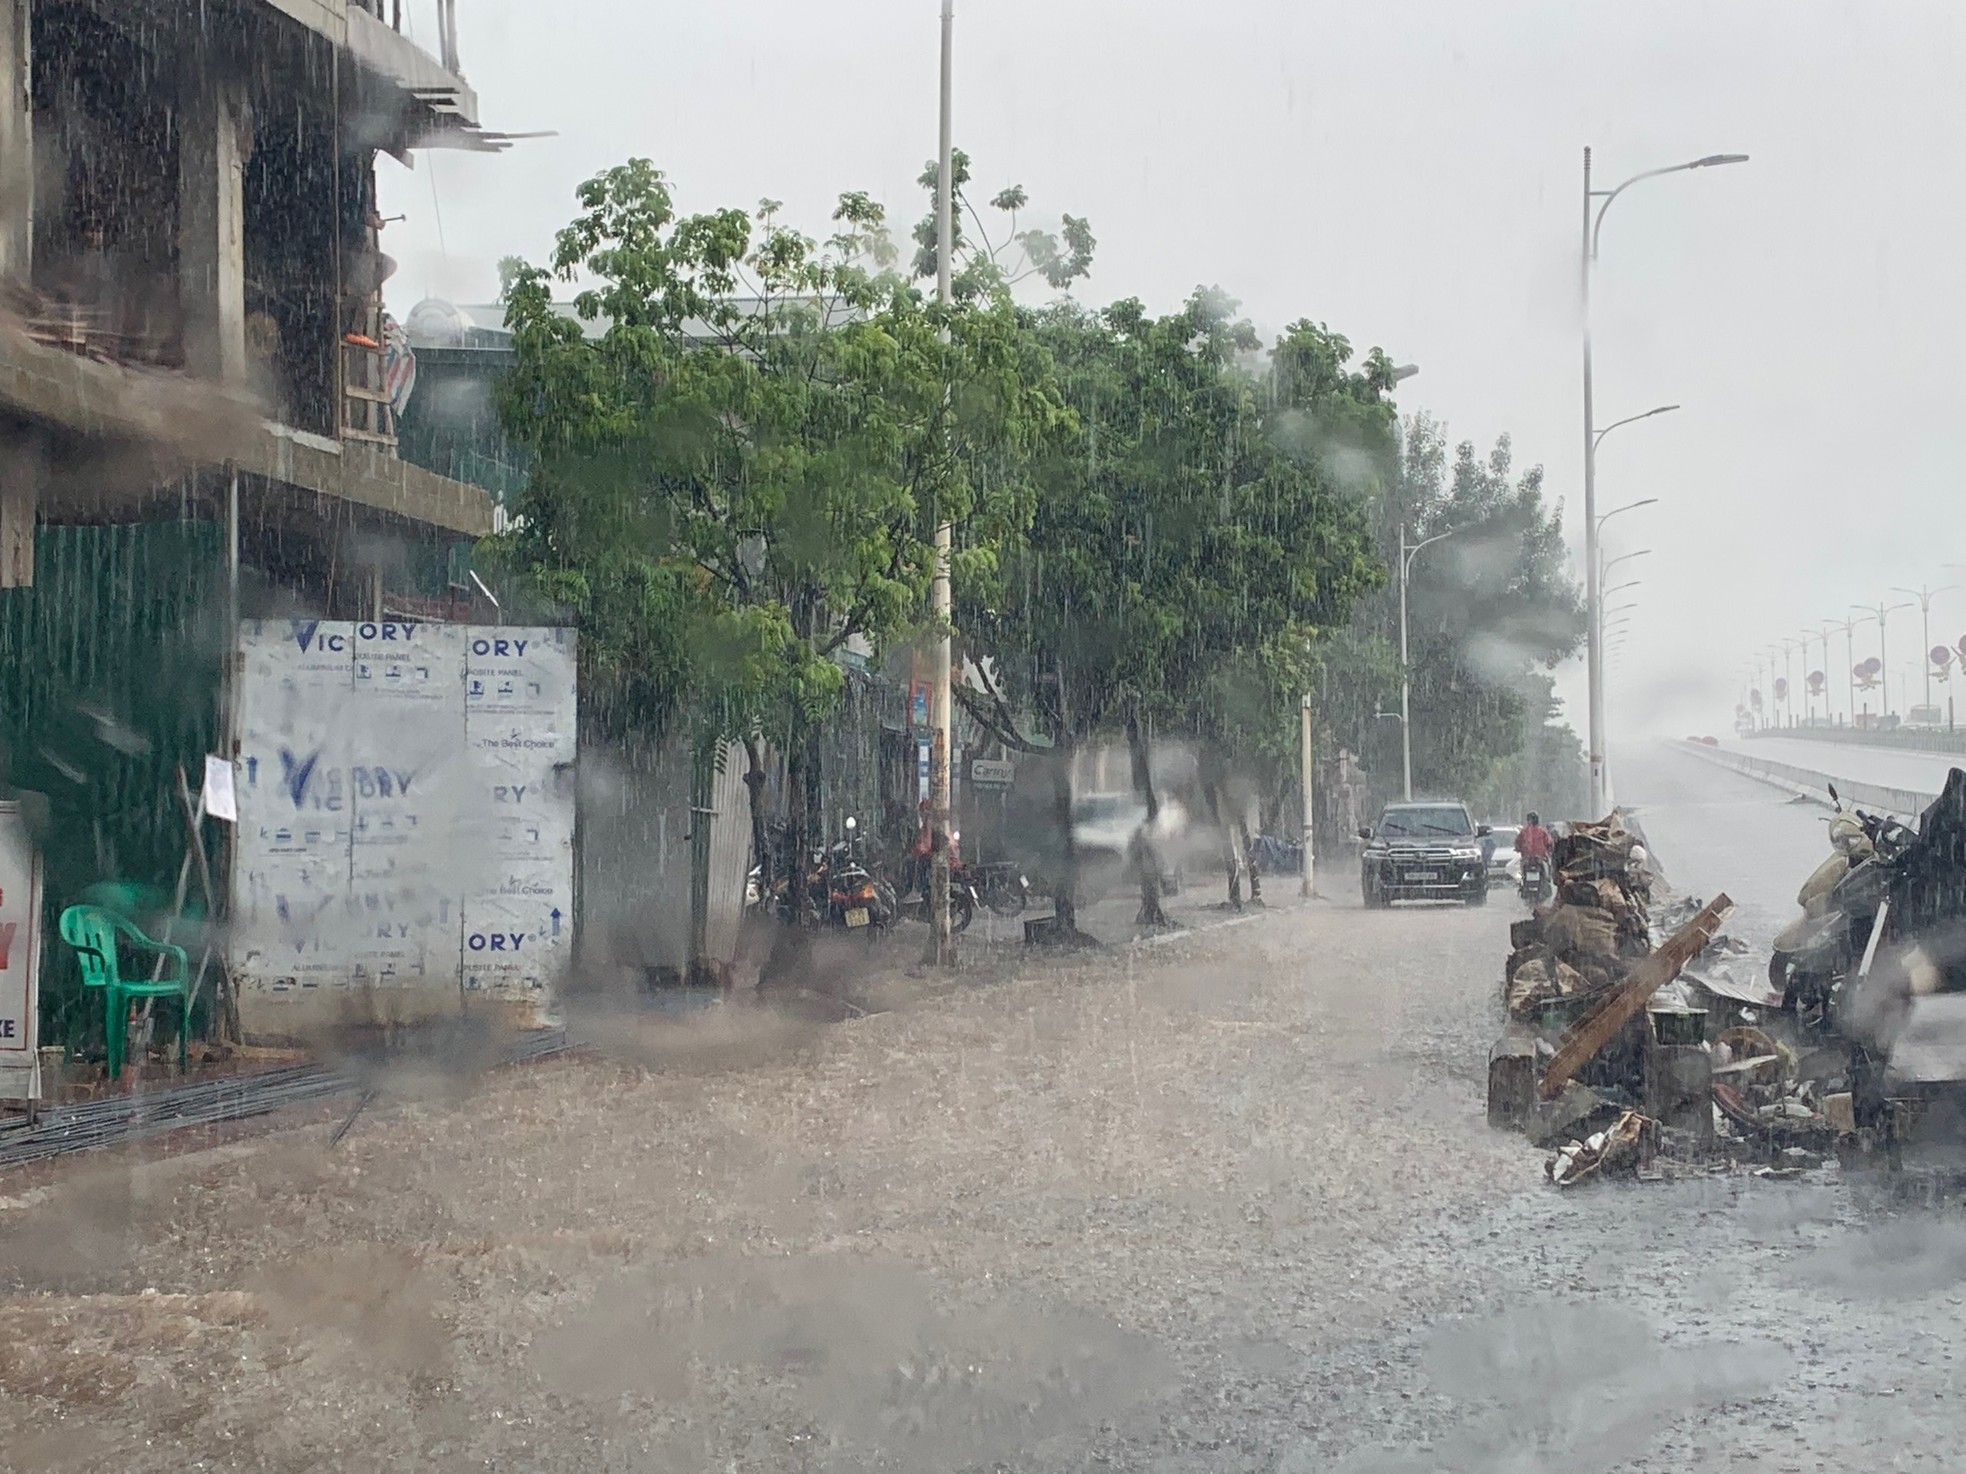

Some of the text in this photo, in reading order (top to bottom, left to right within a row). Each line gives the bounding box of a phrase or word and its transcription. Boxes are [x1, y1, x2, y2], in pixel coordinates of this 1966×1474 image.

[359, 623, 416, 641] ORY
[472, 639, 528, 657] ORY
[468, 933, 526, 951] ORY
